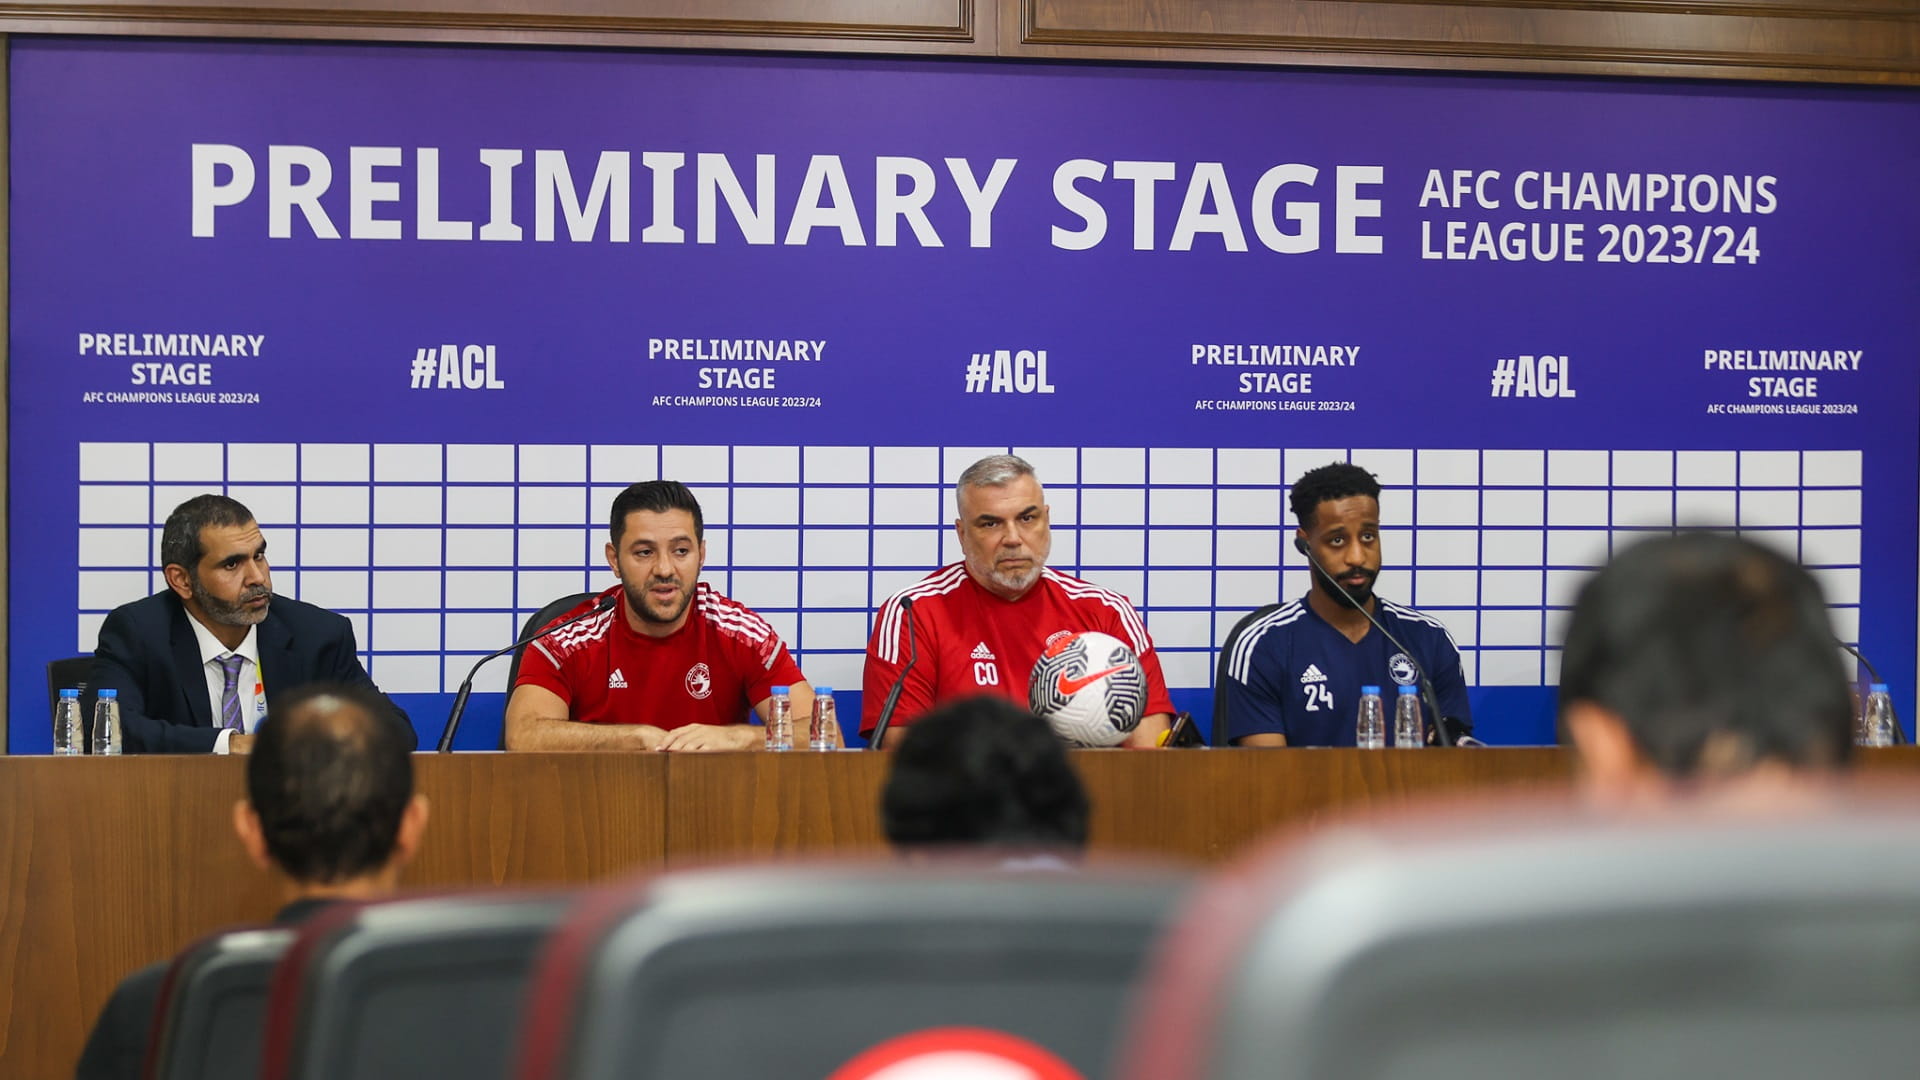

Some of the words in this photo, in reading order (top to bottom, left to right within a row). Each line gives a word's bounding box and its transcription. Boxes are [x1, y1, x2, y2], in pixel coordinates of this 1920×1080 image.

[191, 143, 1018, 249] PRELIMINARY
[1051, 158, 1384, 254] STAGE
[1418, 168, 1501, 210] AFC
[1514, 170, 1777, 214] CHAMPIONS
[1421, 220, 1585, 262] LEAGUE
[1597, 223, 1761, 265] 2023/24
[79, 333, 265, 357] PRELIMINARY
[648, 338, 827, 362] PRELIMINARY
[1191, 344, 1361, 367] PRELIMINARY
[410, 344, 505, 390] #ACL
[965, 349, 1055, 394] #ACL
[1704, 349, 1863, 371] PRELIMINARY
[131, 362, 212, 386] STAGE
[698, 367, 775, 390] STAGE
[1239, 372, 1312, 394] STAGE
[1491, 355, 1576, 398] #ACL
[83, 391, 104, 403] AFC
[106, 392, 173, 403] CHAMPIONS
[175, 392, 217, 404] LEAGUE
[218, 392, 260, 404] 2023/24
[1748, 376, 1817, 398] STAGE
[652, 395, 672, 406] AFC
[674, 395, 738, 407] CHAMPIONS
[740, 396, 780, 407] LEAGUE
[781, 396, 822, 408] 2023/24
[1195, 400, 1214, 410] AFC
[1216, 400, 1277, 411] CHAMPIONS
[1278, 400, 1316, 411] LEAGUE
[1317, 401, 1355, 411] 2023/24
[1707, 403, 1725, 414] AFC
[1726, 404, 1784, 414] CHAMPIONS
[1785, 404, 1821, 414] LEAGUE
[1822, 404, 1858, 415] 2023/24
[974, 661, 999, 686] CO
[1303, 684, 1334, 711] 24
